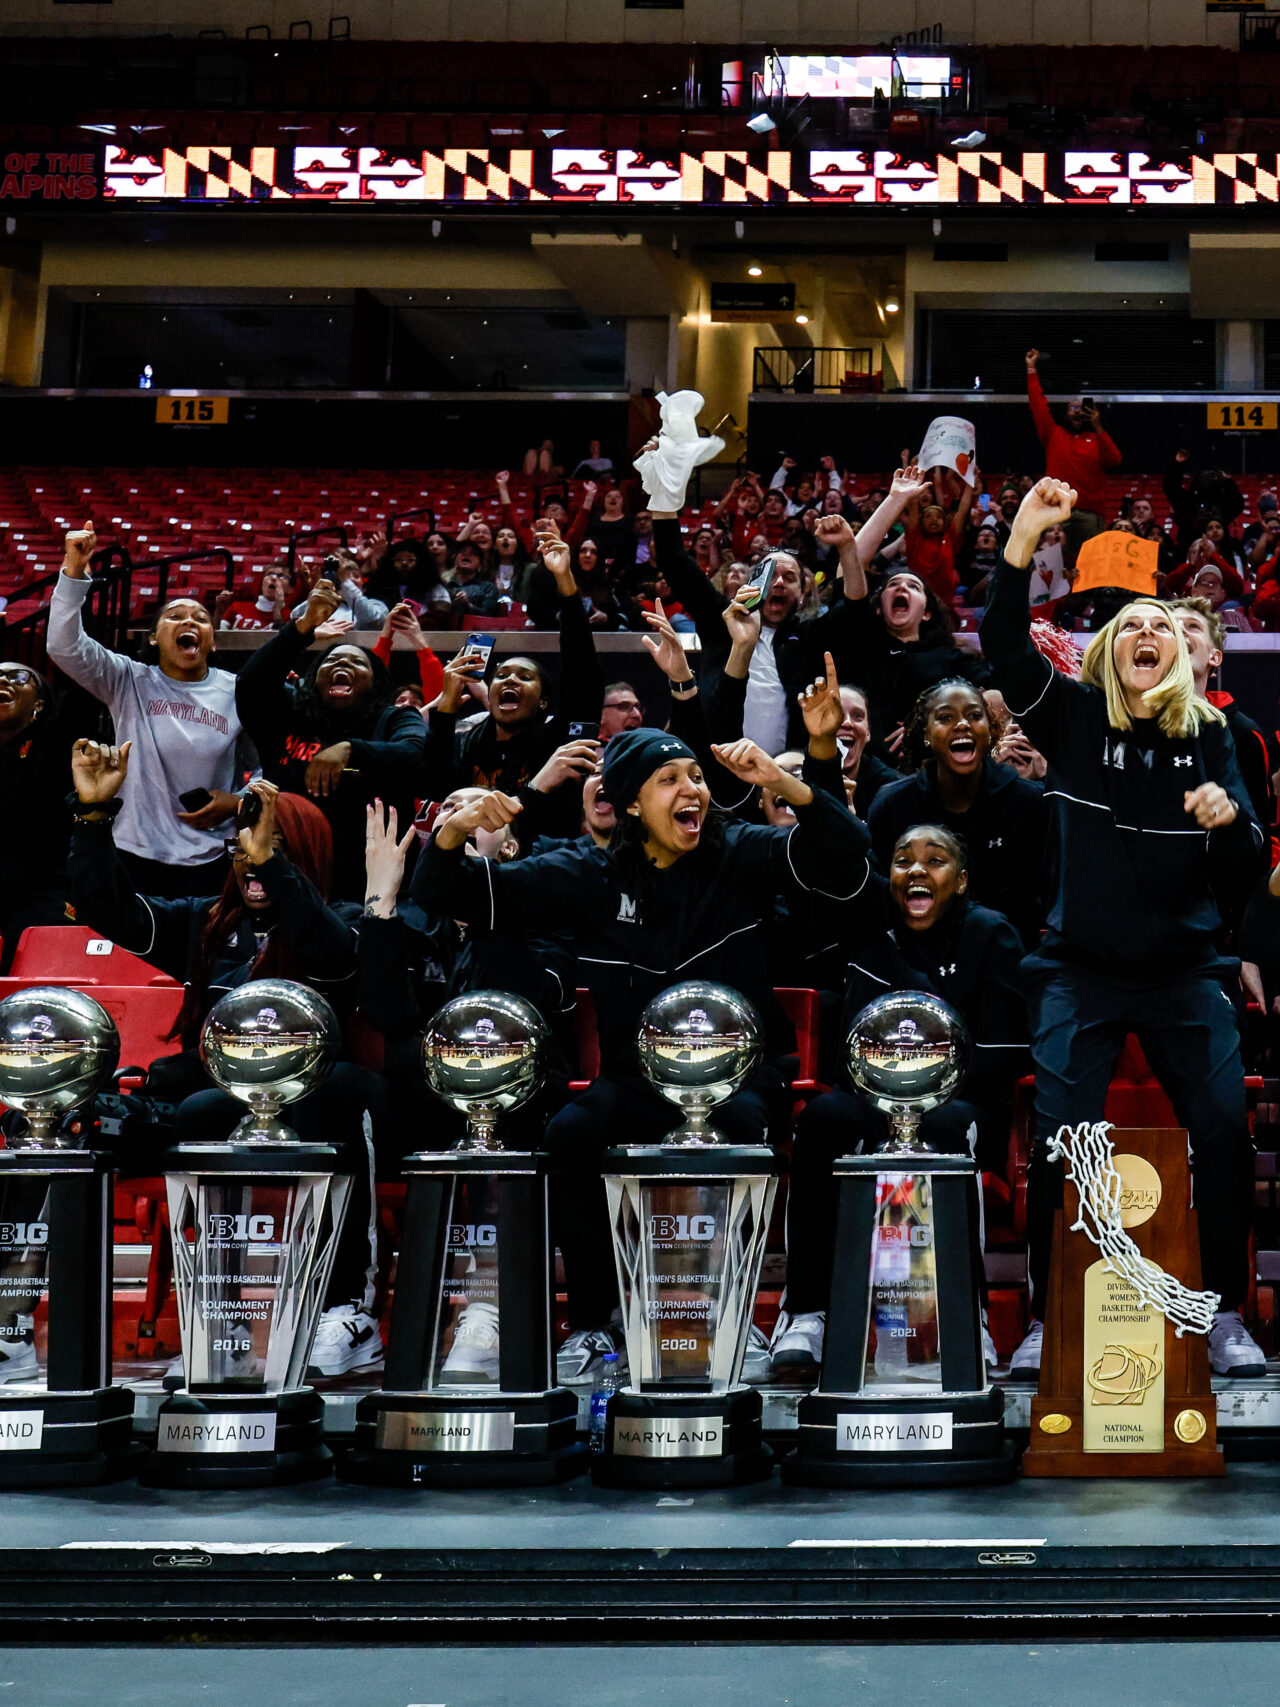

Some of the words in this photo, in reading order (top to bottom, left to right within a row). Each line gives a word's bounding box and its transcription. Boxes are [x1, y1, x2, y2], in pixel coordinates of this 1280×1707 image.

[4, 153, 40, 173] OF
[45, 153, 96, 173] THE
[170, 400, 214, 421] 115
[1221, 406, 1264, 426] 114
[145, 699, 229, 735] MARYLAND
[96, 943, 103, 952] 6
[1097, 1189, 1159, 1210] CAA
[197, 1275, 231, 1284] WOMEN'S
[232, 1275, 281, 1284] BASKETBALL
[677, 1275, 723, 1283] BASKETBALL
[443, 1290, 495, 1298] CHAMPIONS
[1110, 1293, 1141, 1301] WOMEN'S
[201, 1301, 271, 1309] TOURNAMENT
[648, 1301, 715, 1309] TOURNAMENT
[202, 1311, 268, 1320] CHAMPIONS
[649, 1311, 712, 1320] CHAMPIONS
[0, 1326, 27, 1336] 2015
[890, 1327, 917, 1337] 2021
[213, 1339, 251, 1351] 2016
[661, 1339, 698, 1351] 2020
[167, 1424, 266, 1441] MARYLAND
[410, 1427, 471, 1438] MARYLAND
[846, 1424, 944, 1441] MARYLAND
[1104, 1424, 1143, 1432] NATIONAL
[618, 1430, 718, 1443] MARYLAND
[1103, 1434, 1144, 1443] CHAMPION
